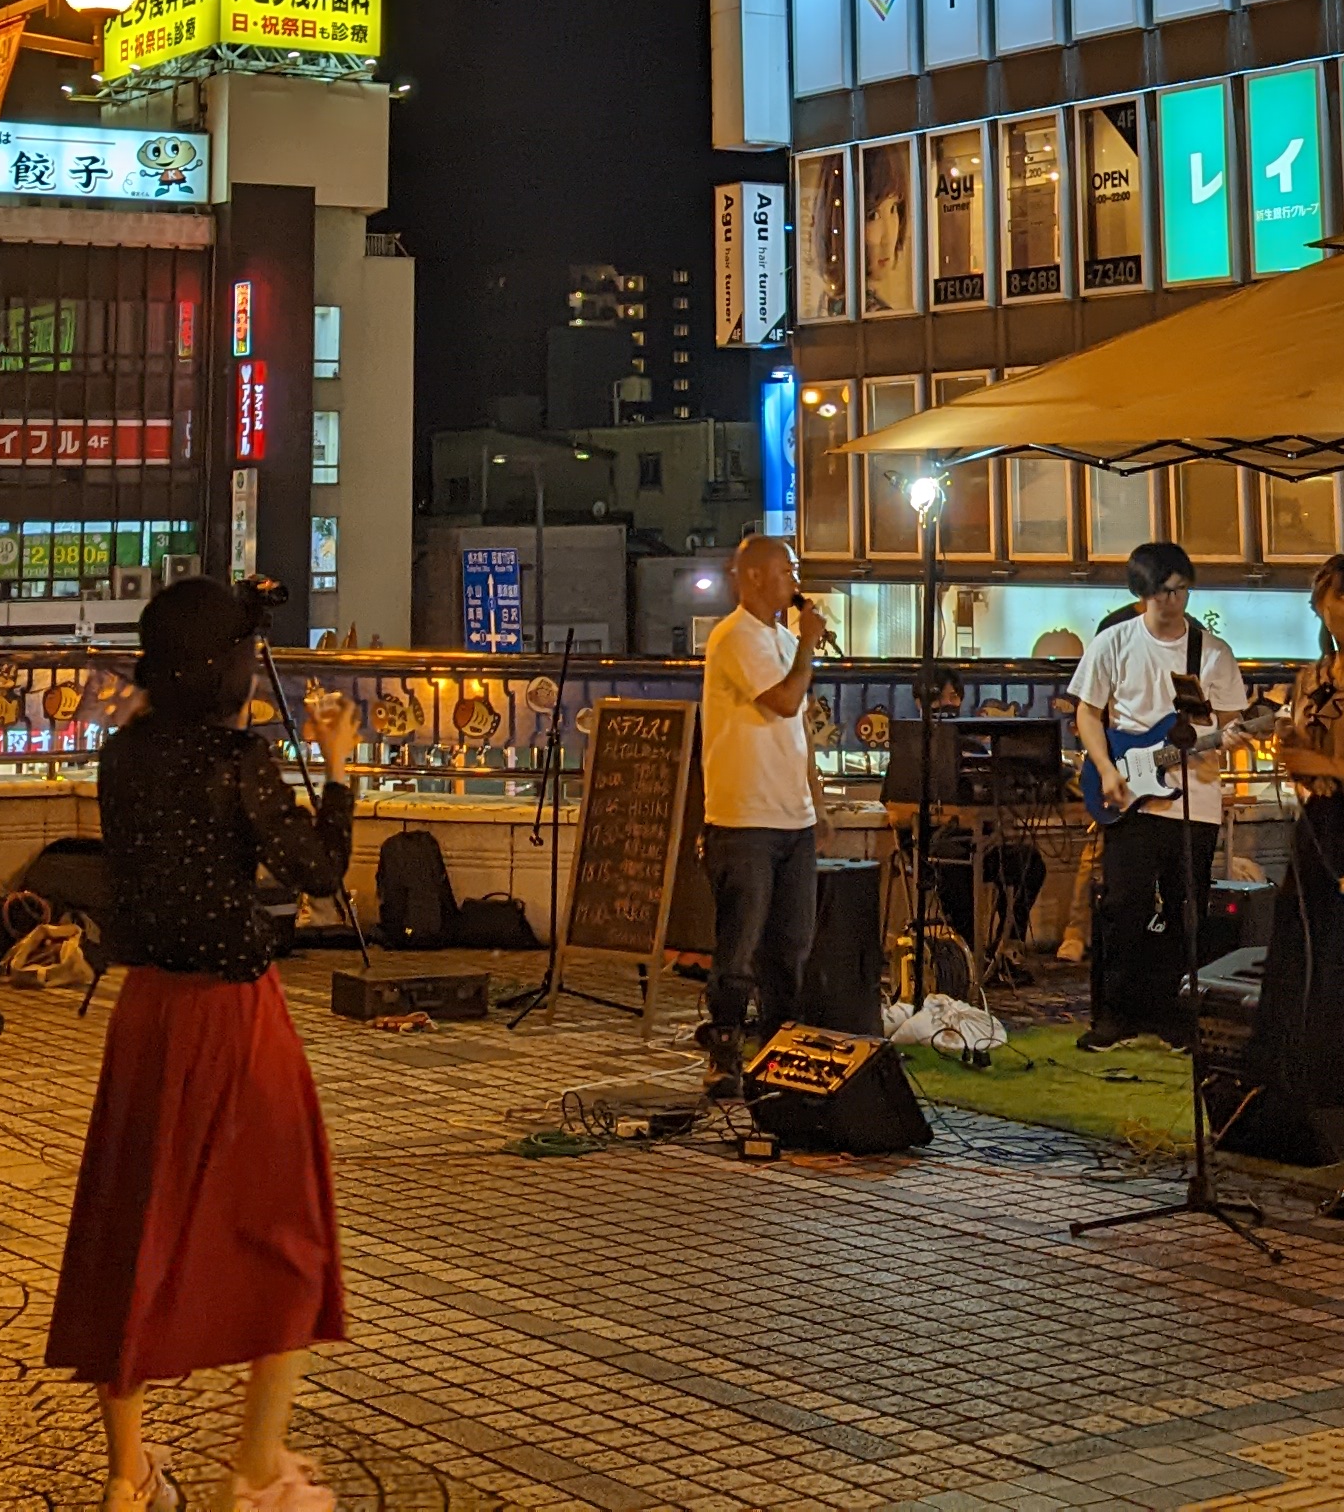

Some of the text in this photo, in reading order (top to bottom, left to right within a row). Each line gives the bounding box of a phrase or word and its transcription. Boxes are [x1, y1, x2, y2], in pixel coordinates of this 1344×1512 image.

[934, 173, 975, 201] Agu
[1091, 168, 1130, 191] OPEN
[754, 192, 772, 325] Agu hair turner
[769, 329, 784, 341] 4F
[87, 435, 110, 450] 4F
